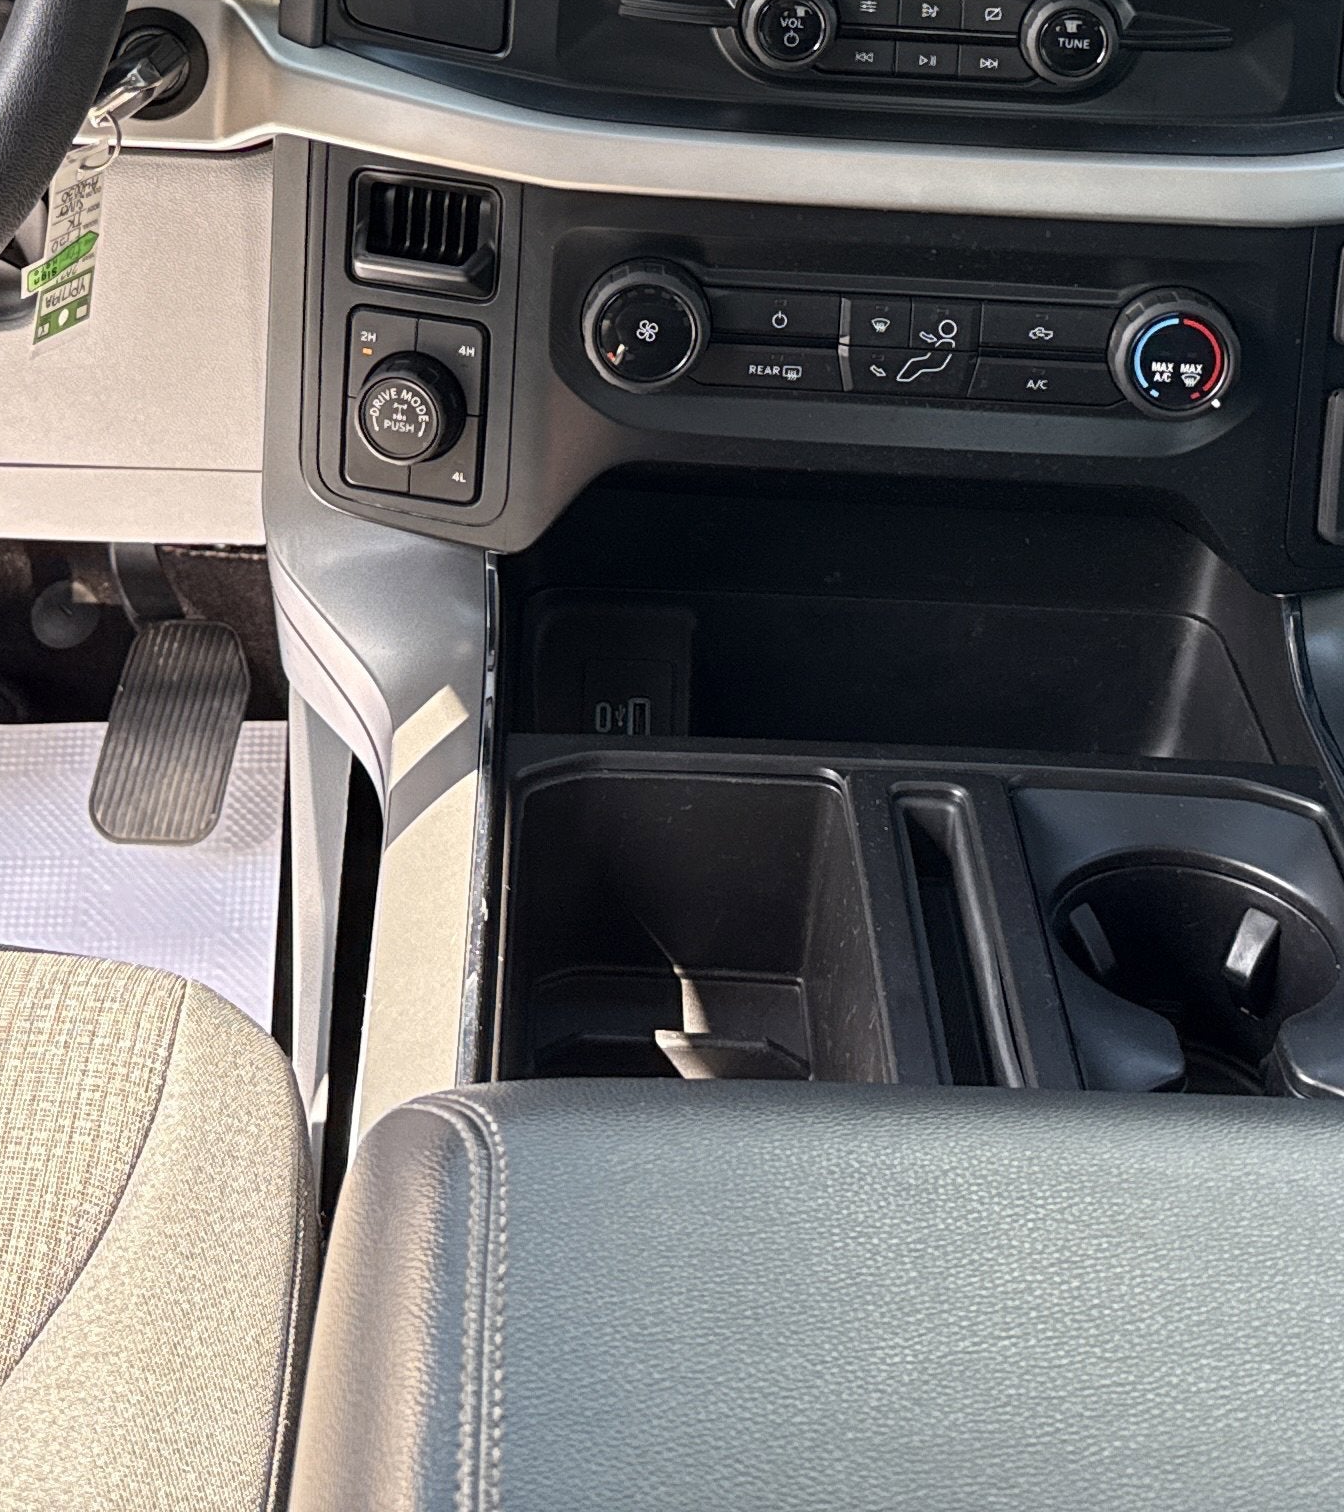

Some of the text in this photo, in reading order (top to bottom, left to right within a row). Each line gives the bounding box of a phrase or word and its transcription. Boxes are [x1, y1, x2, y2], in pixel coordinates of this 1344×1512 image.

[780, 17, 805, 30] VOL
[1057, 37, 1091, 51] TUNE
[360, 330, 377, 343] 2H
[458, 345, 475, 357] 4H
[748, 364, 781, 375] REAR
[1151, 361, 1174, 372] MAX
[1180, 363, 1203, 374] MAX
[1153, 372, 1172, 383] A/C
[1026, 379, 1048, 390] A/C
[370, 388, 429, 422] DRIVE MODE
[383, 420, 414, 433] PUSH
[452, 471, 466, 483] 4L
